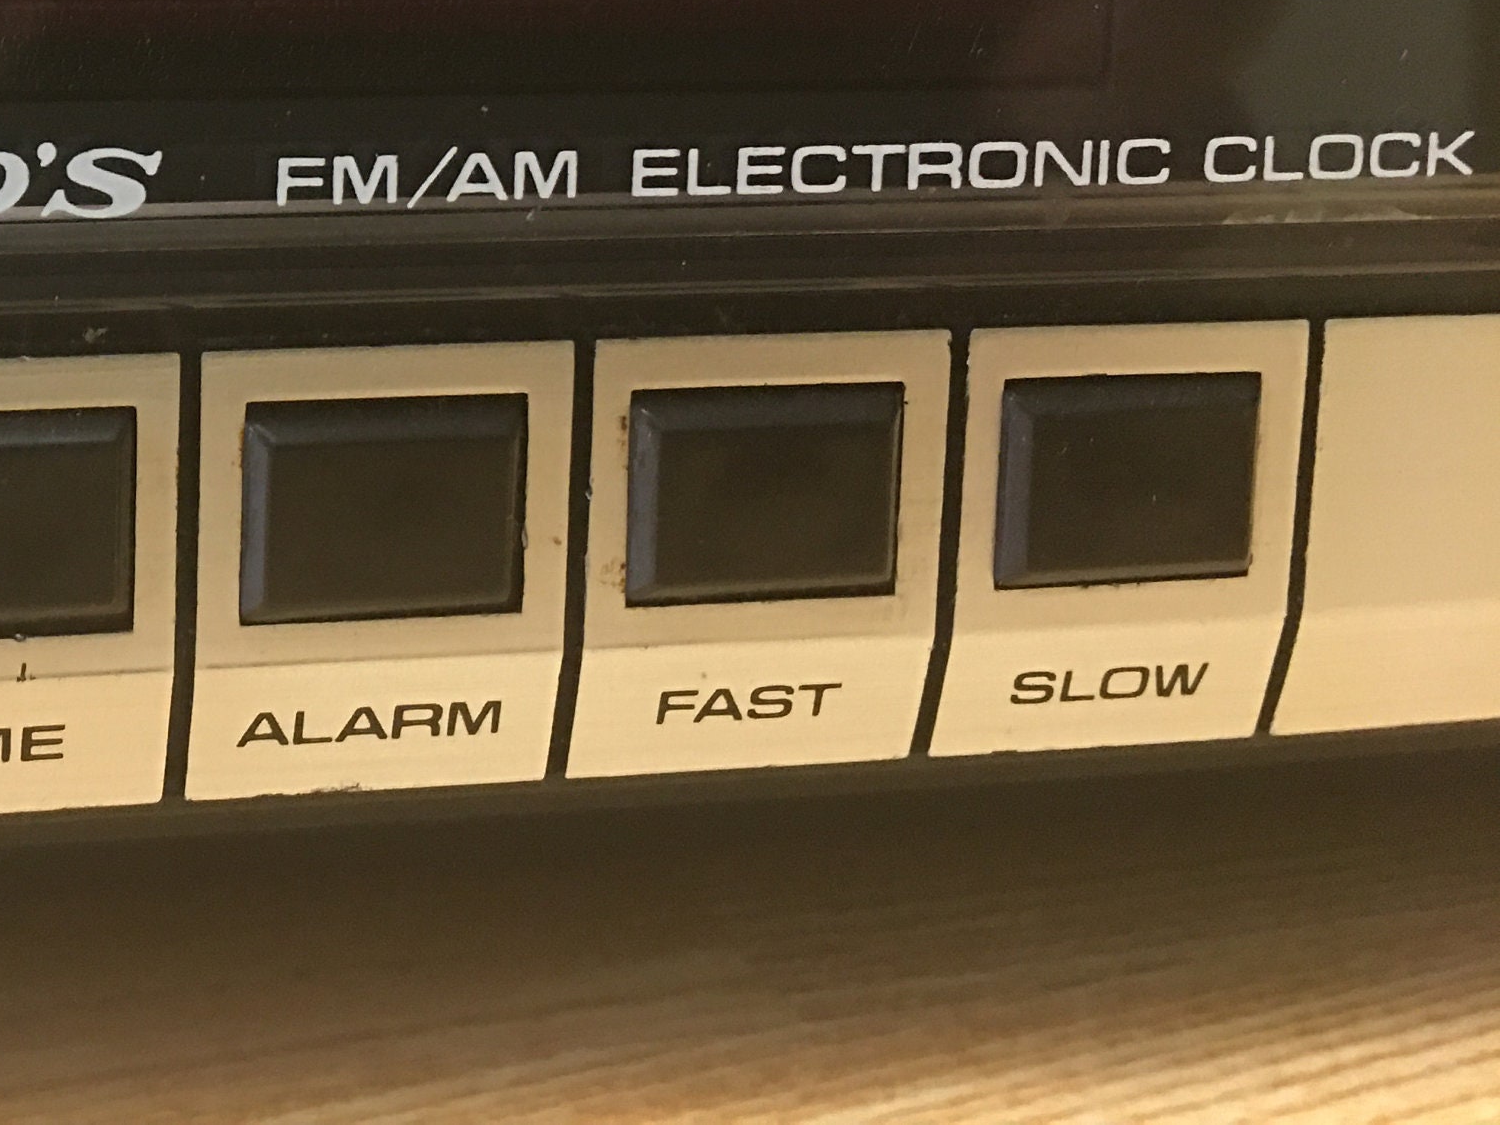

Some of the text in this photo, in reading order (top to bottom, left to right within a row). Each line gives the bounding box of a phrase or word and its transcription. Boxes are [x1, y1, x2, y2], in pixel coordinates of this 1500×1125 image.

[276, 130, 1475, 208] FM/AM ELECTRONIC CLOCK
[656, 682, 842, 725] FAST
[1010, 662, 1209, 705] SLOW
[237, 700, 502, 748] ALARM
